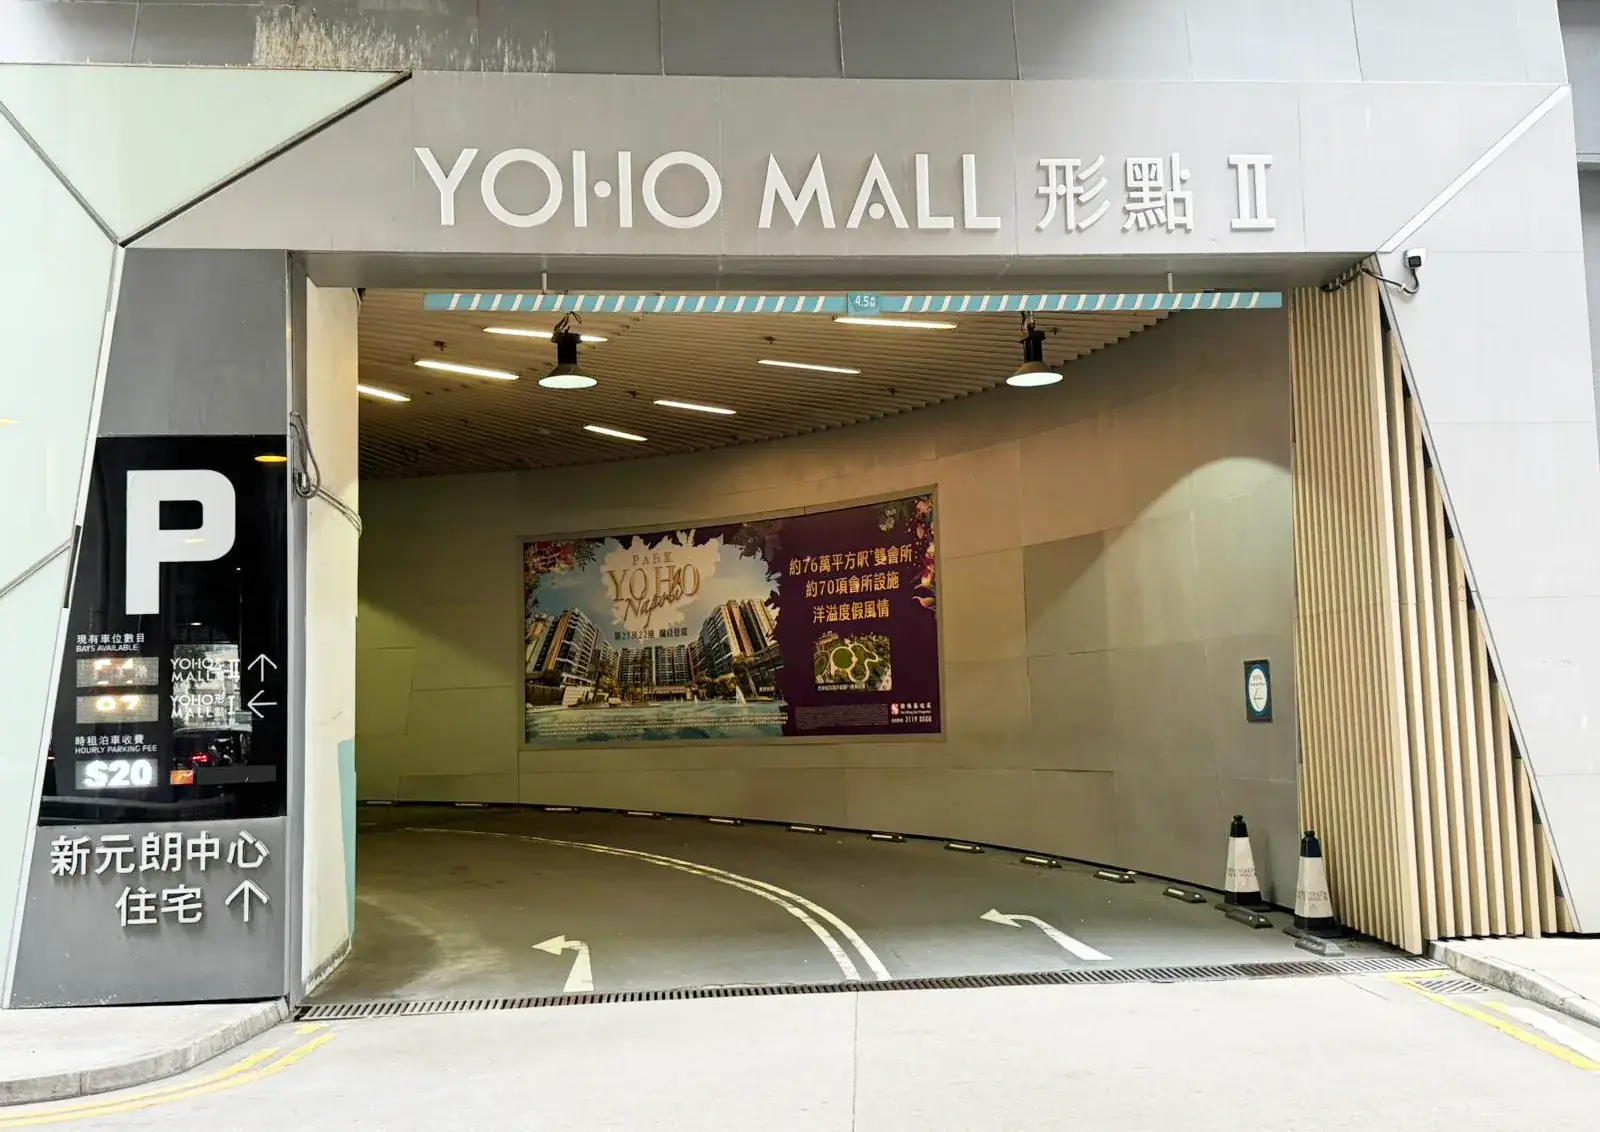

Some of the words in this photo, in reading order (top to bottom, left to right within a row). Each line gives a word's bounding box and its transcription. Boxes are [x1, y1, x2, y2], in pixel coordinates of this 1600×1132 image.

[414, 147, 722, 228] YOHO
[758, 152, 1001, 229] MALL
[1035, 152, 1195, 233] 形點
[126, 469, 236, 615] P
[632, 551, 673, 566] PARK
[606, 563, 701, 601] YOHO
[805, 571, 900, 598] 約70項會所設施
[813, 598, 890, 624] 洋溢度假風情
[76, 633, 145, 645] 現有車位數目
[76, 645, 96, 653] BAYS
[97, 643, 140, 652] AVAILABLE
[170, 657, 214, 670] YOHO
[171, 670, 213, 682] MALL
[170, 694, 214, 706] YOHO
[170, 706, 213, 719] MALL
[75, 734, 145, 746] 時租泊車收費
[75, 746, 105, 754] HOURLY
[106, 745, 141, 753] PARKING
[142, 744, 158, 752] FEE
[83, 759, 153, 788] $20
[49, 829, 271, 877] 新元朗中心
[115, 883, 204, 927] 住宅
